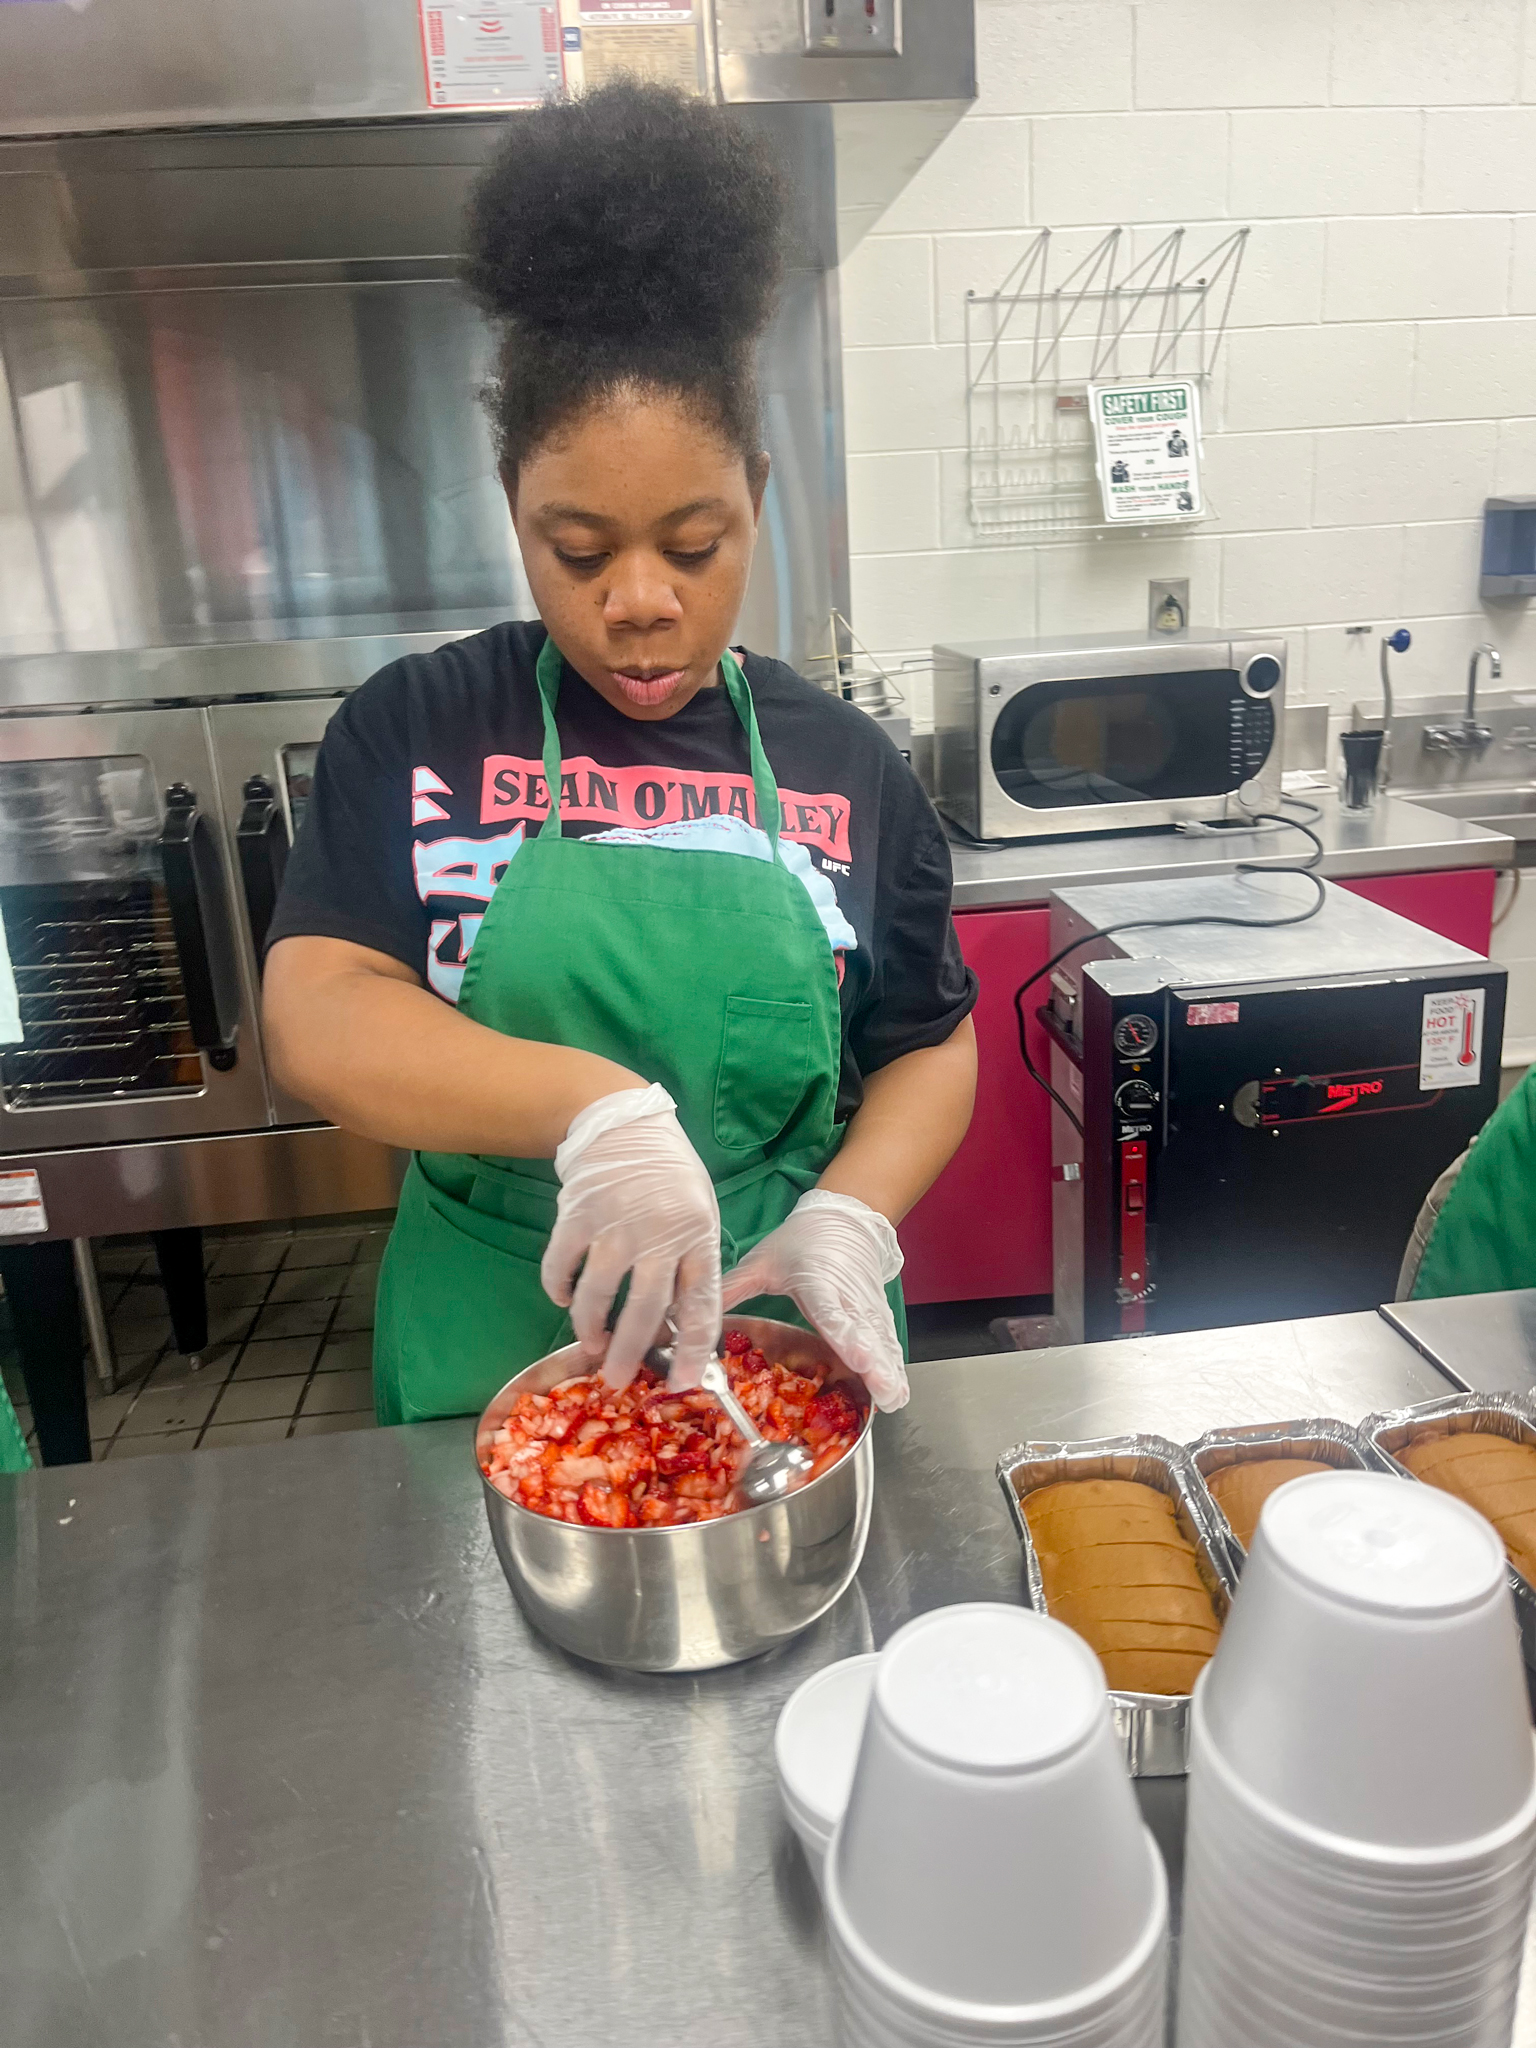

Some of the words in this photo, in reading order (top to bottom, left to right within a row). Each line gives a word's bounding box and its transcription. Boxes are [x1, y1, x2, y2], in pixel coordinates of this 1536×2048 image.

[1105, 394, 1149, 414] SAFETY
[1151, 391, 1183, 411] FIRST
[494, 769, 619, 812] SEAN
[822, 858, 850, 876] UFC
[1426, 1016, 1455, 1028] HOT
[1325, 1081, 1383, 1103] METRO
